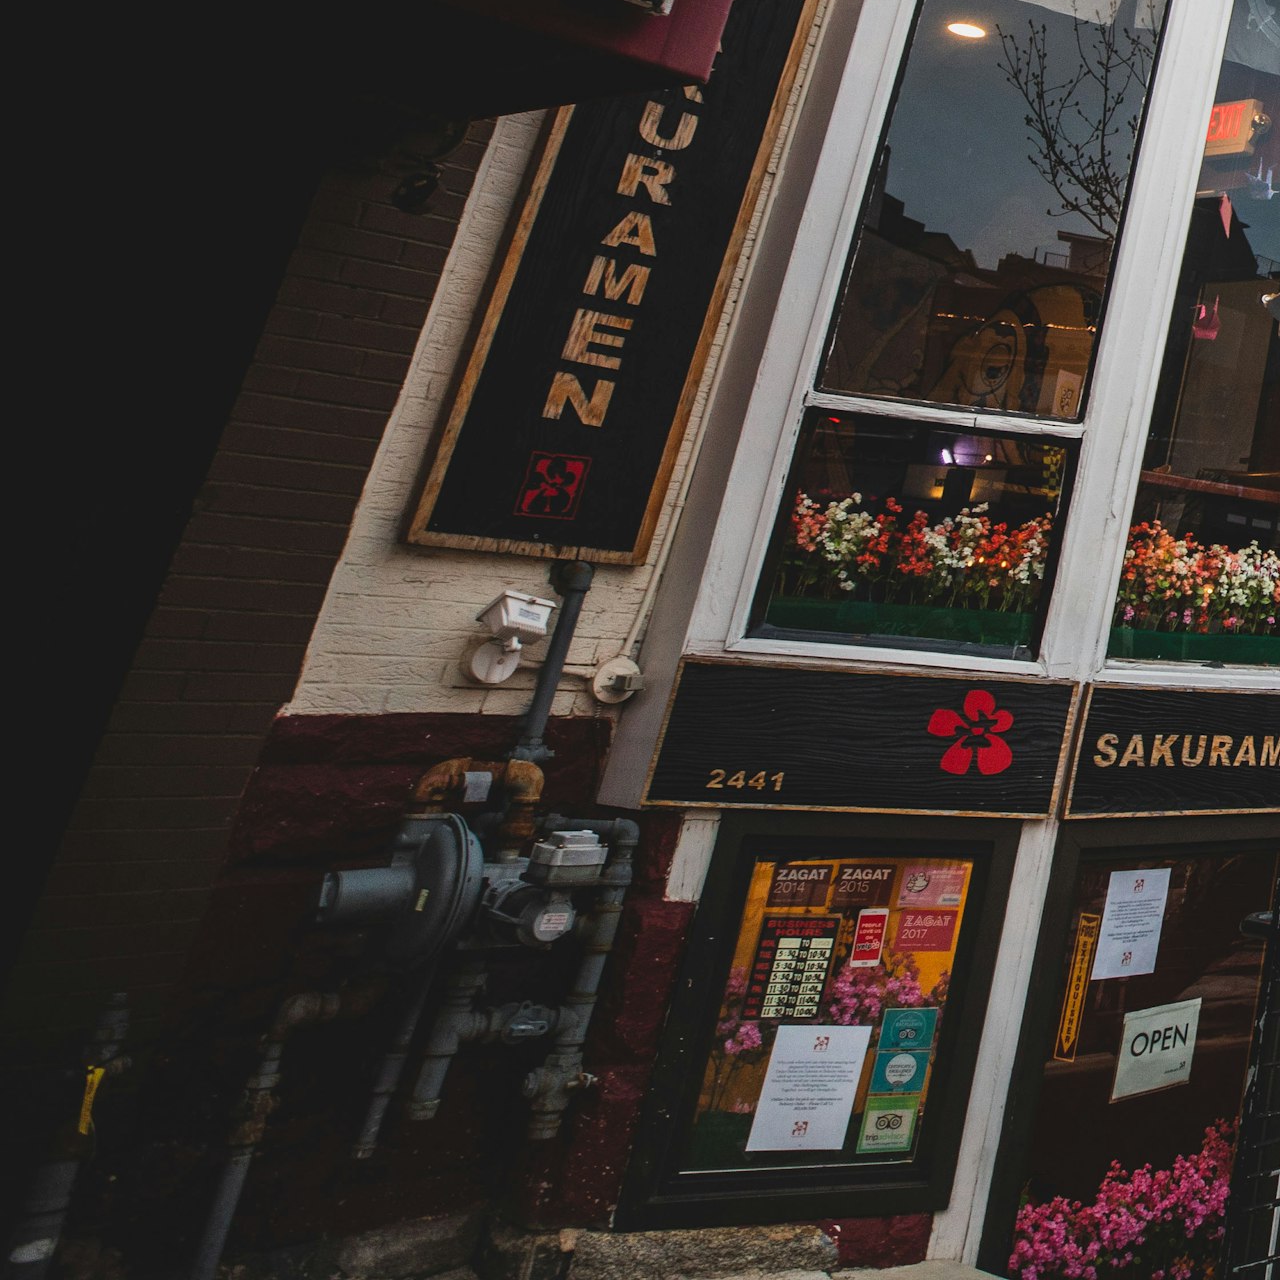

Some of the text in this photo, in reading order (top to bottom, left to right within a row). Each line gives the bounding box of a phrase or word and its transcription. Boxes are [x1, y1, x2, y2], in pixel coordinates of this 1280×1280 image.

[1206, 105, 1246, 141] EXIT
[542, 84, 704, 428] URAMEN
[705, 768, 785, 792] 2441
[777, 868, 828, 881] ZAGAT
[841, 868, 893, 881] ZAGAT
[773, 881, 807, 894] 2014
[838, 880, 870, 893] 2015
[767, 920, 835, 928] BUSINESS
[904, 915, 952, 927] ZAGAT
[901, 928, 928, 939] 2017
[1080, 924, 1095, 938] FIRE
[1064, 940, 1088, 1044] EXTINGUISHER
[1130, 1022, 1189, 1058] OPEN
